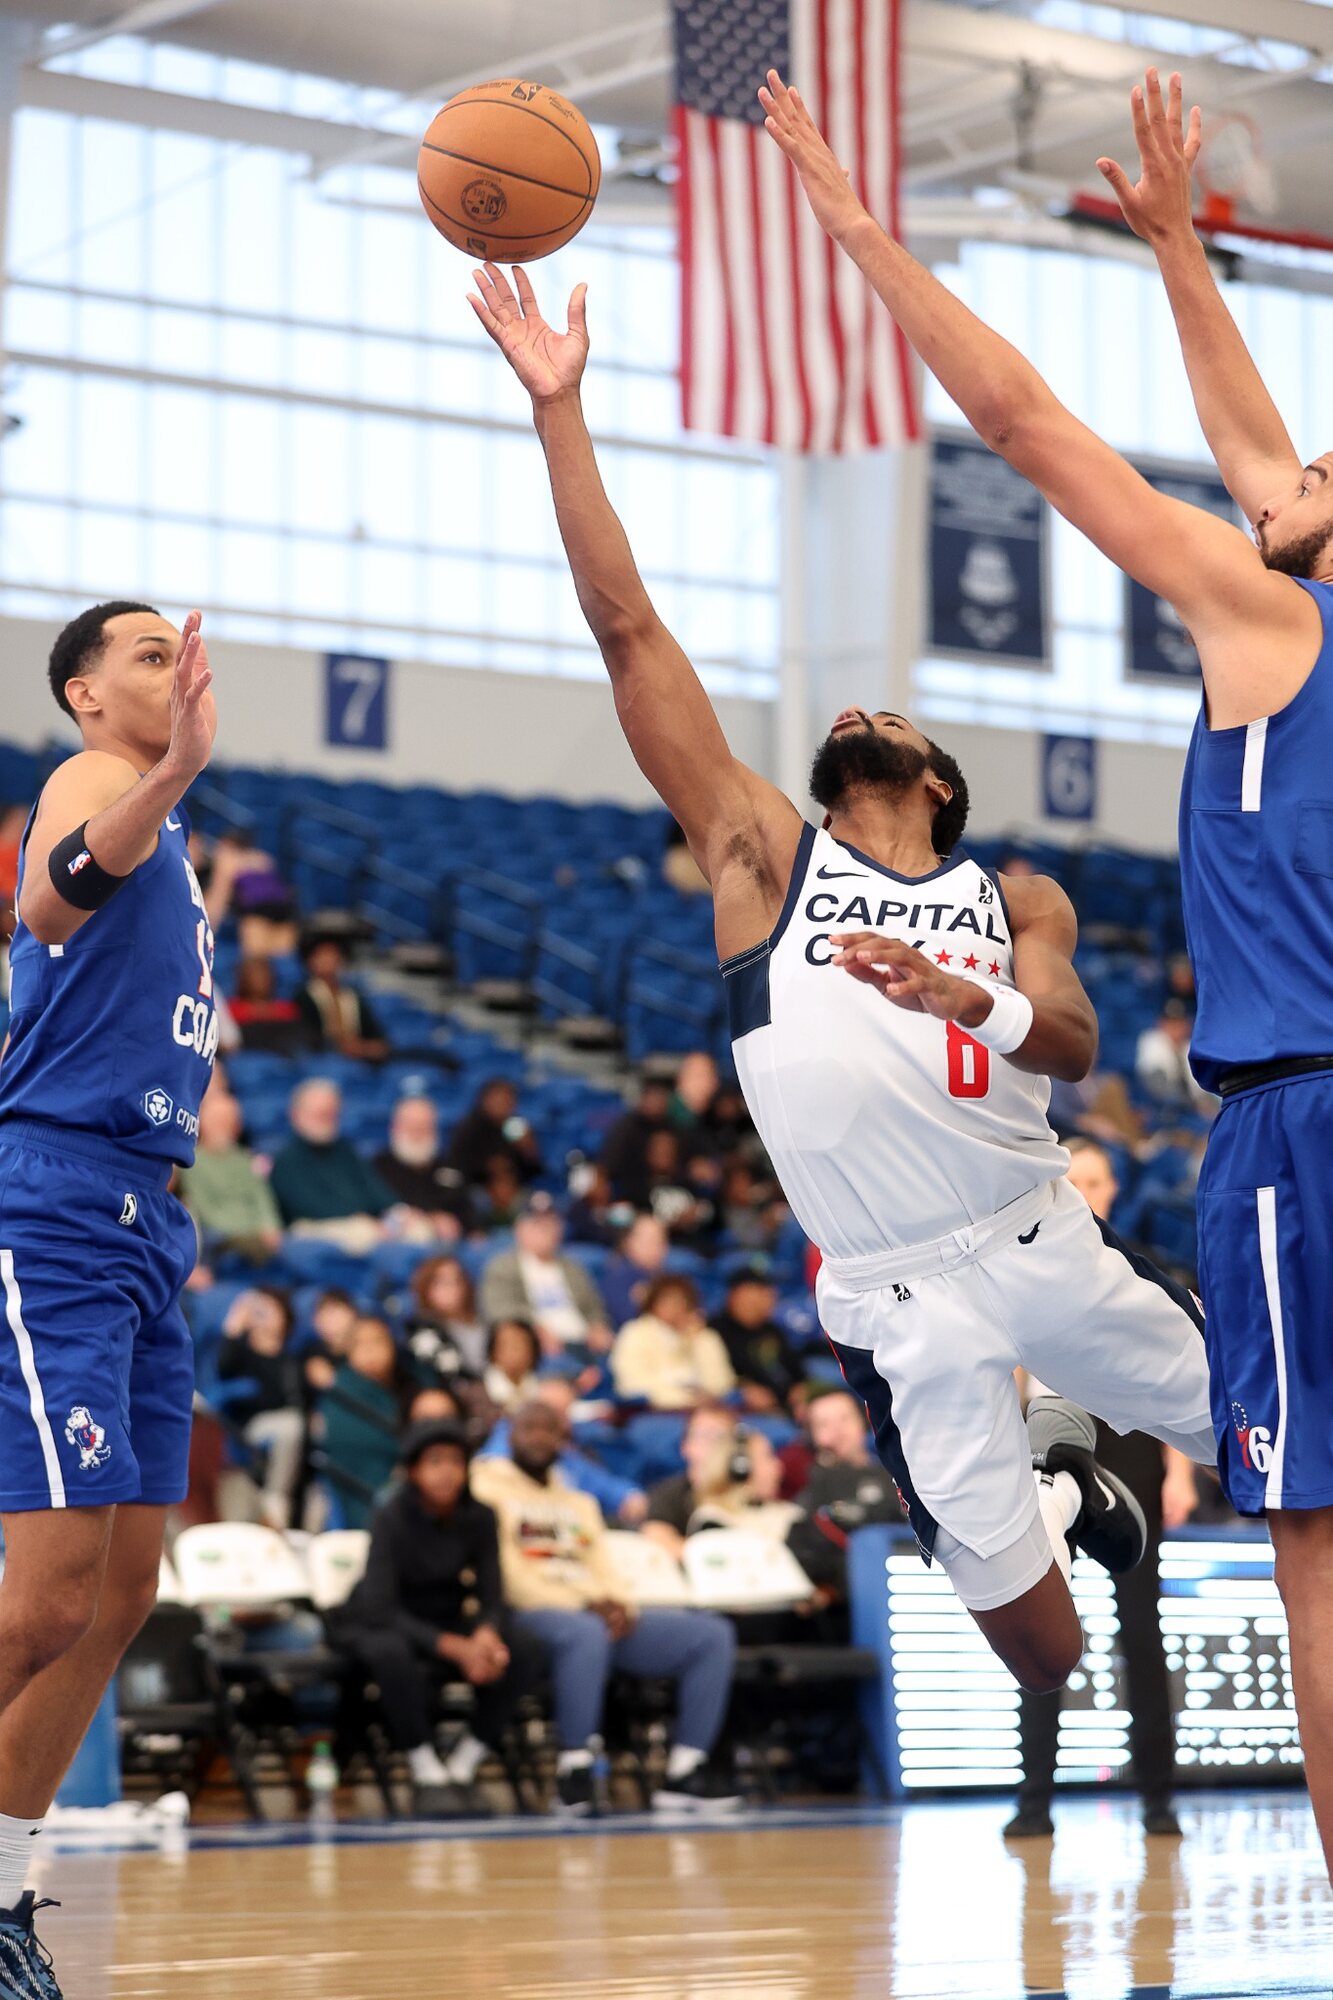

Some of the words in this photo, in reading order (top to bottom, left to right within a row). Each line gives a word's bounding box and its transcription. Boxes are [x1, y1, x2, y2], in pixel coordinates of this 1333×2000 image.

[334, 660, 381, 739] 7
[1049, 739, 1091, 813] 6
[805, 893, 1007, 946] CAPITAL
[172, 993, 219, 1068] COA
